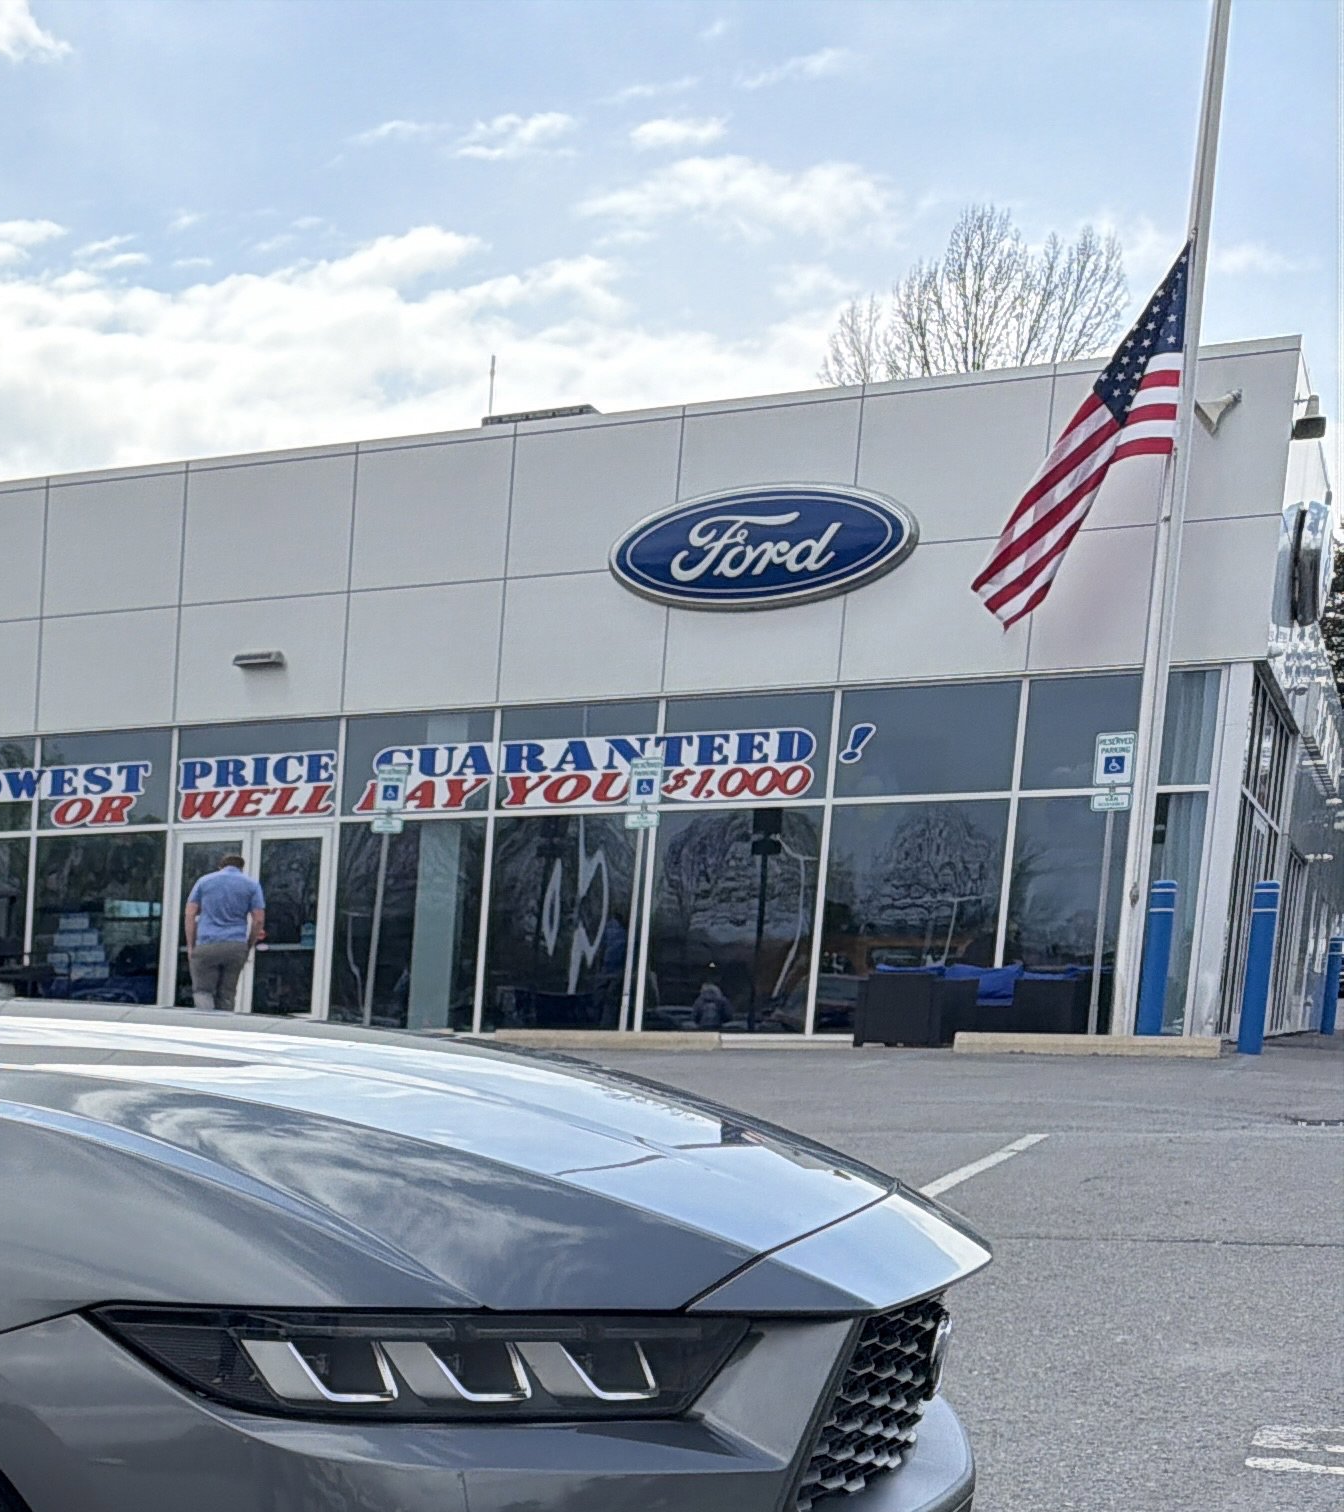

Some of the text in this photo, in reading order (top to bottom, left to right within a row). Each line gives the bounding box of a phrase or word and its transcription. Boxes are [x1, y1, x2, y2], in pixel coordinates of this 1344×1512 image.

[670, 511, 843, 582] Ford
[54, 796, 135, 824] OR
[181, 785, 333, 820] WE'LL
[506, 772, 629, 805] YOU
[663, 765, 811, 798] $1,000
[181, 753, 335, 790] PRICE
